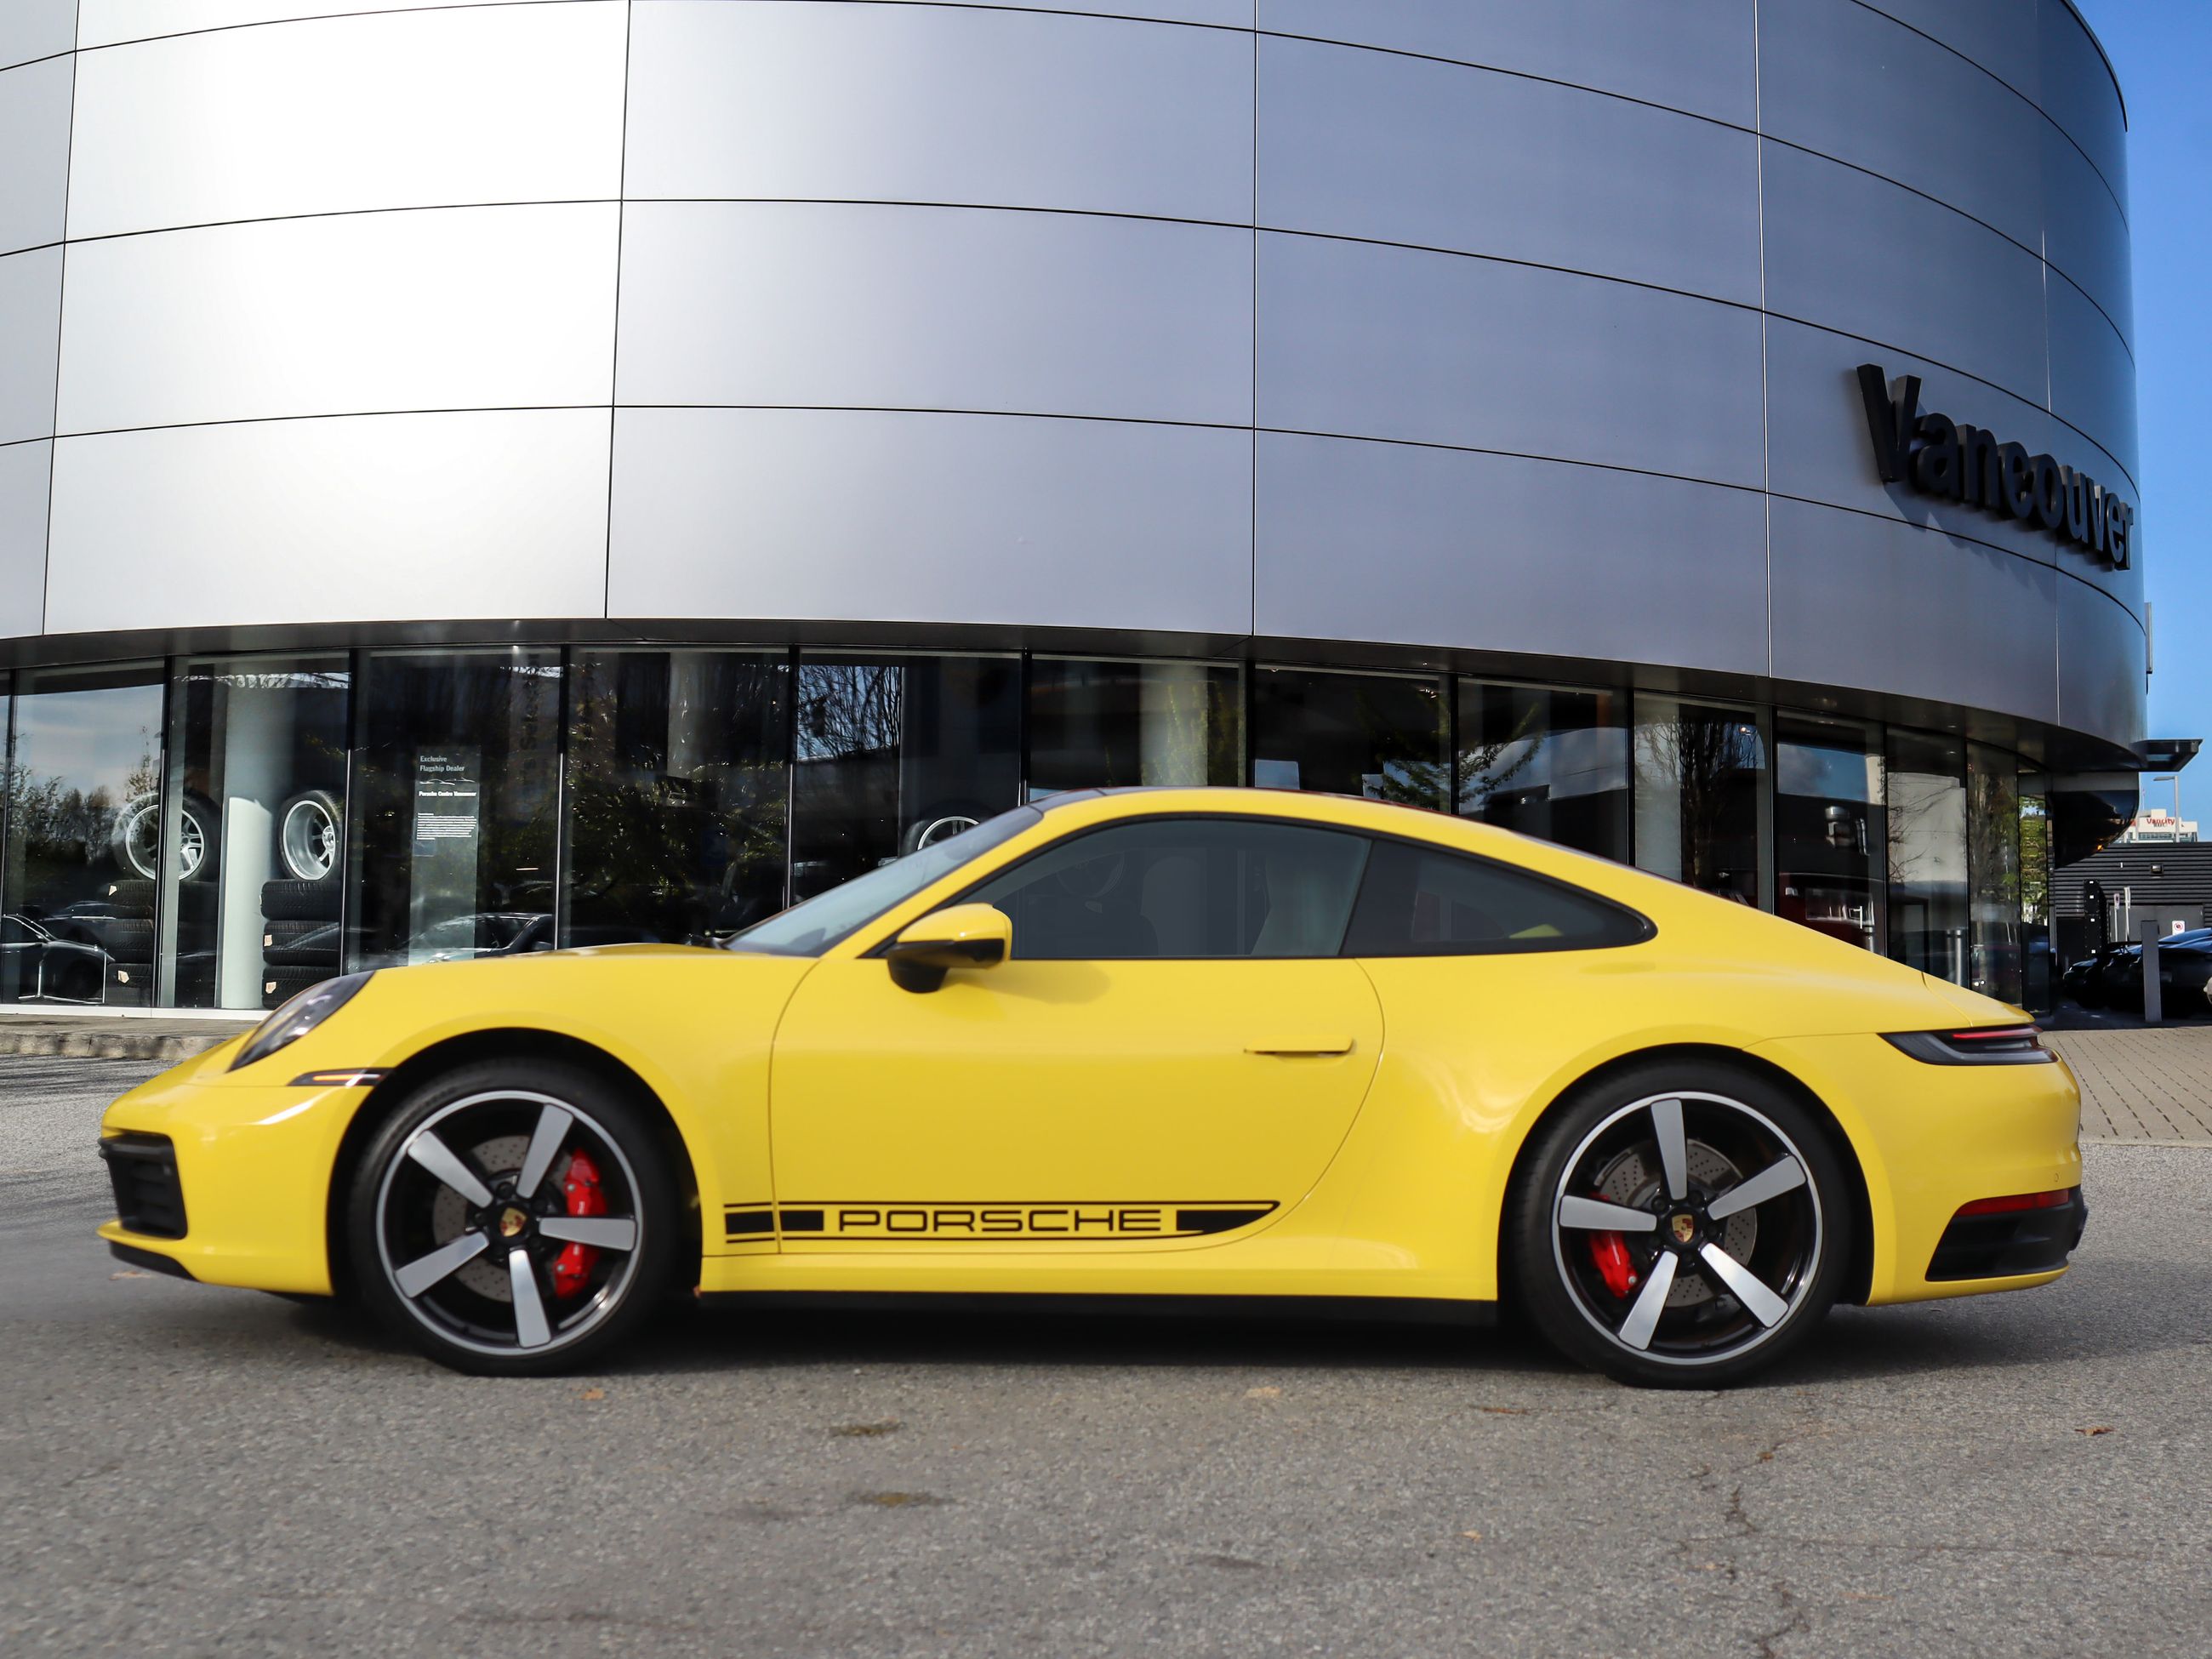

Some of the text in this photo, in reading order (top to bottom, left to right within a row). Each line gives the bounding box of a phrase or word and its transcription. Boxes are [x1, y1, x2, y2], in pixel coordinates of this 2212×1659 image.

[1856, 363, 2134, 571] Vancouver
[2146, 817, 2175, 825] Vancity
[839, 1210, 1161, 1232] PORSCHE
